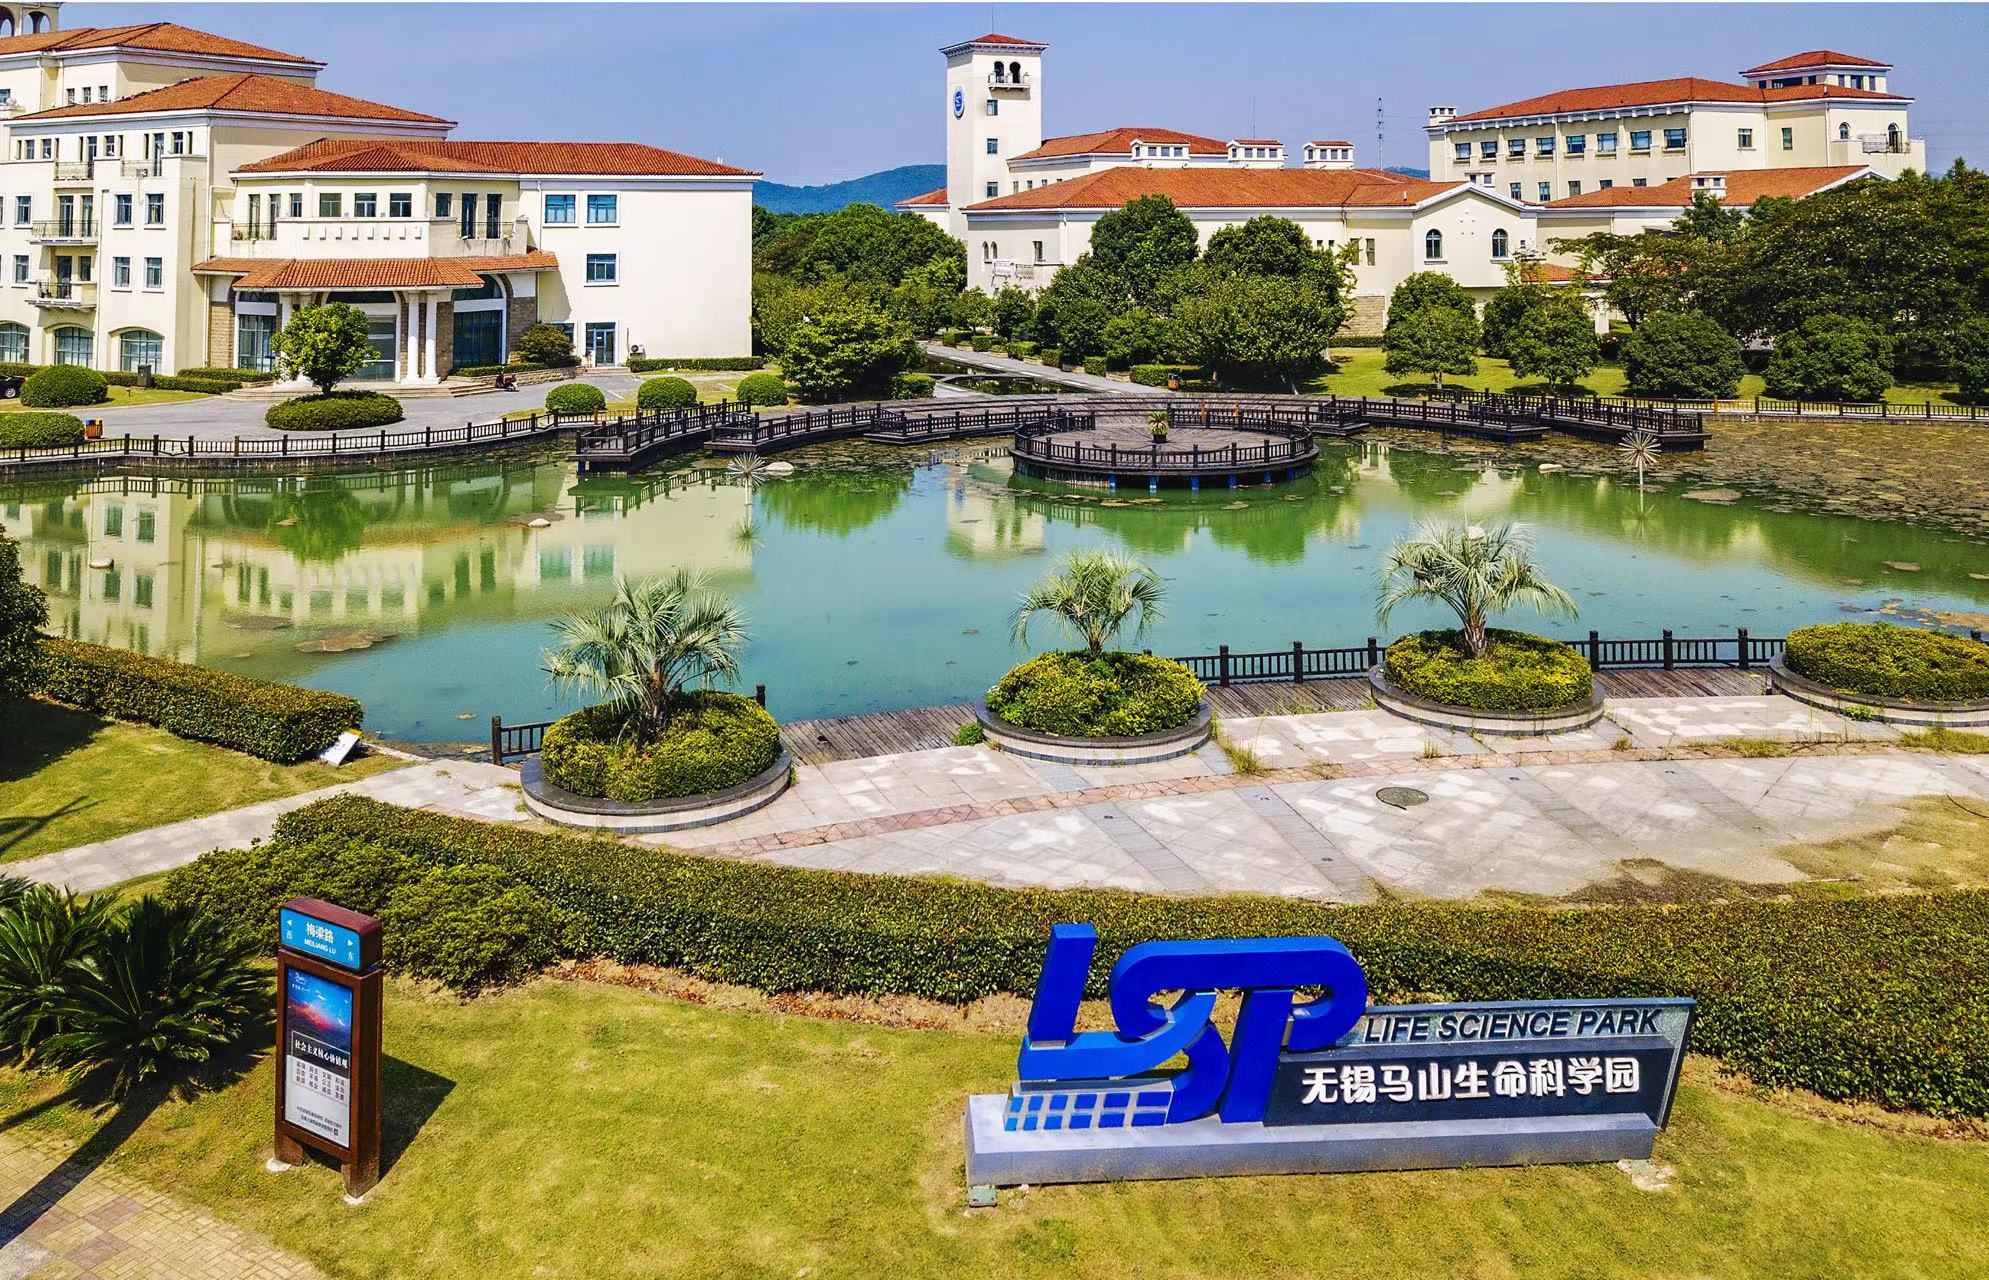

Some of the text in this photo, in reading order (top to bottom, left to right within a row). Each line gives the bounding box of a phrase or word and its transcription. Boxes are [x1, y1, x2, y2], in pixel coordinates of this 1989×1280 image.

[286, 930, 293, 939] 西
[305, 922, 334, 944] 梅梁路
[304, 938, 337, 955] MEILIANG LU
[1363, 1008, 1663, 1043] LIFE SCIENCE PARK
[294, 1039, 348, 1069] 社会主义核心价值观
[1301, 1056, 1640, 1105] 无锡马山生命科学园
